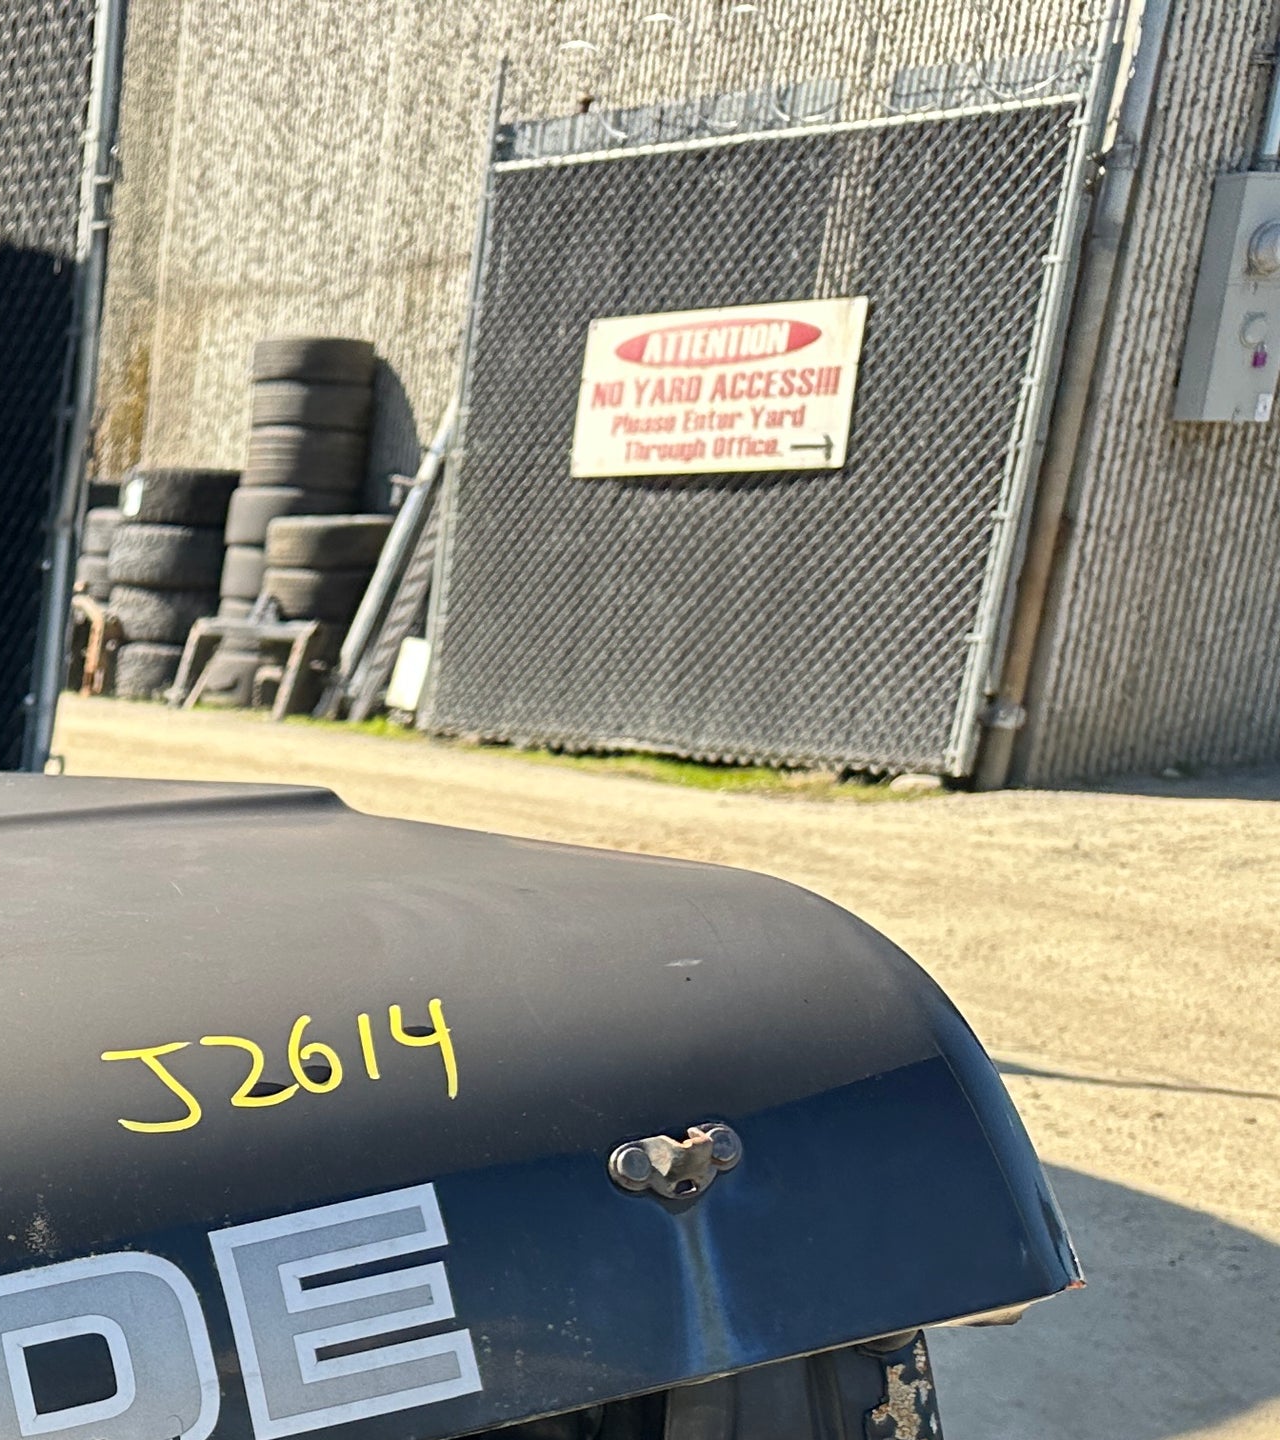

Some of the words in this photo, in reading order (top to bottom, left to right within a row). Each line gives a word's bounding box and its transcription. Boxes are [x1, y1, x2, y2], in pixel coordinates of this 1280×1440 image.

[642, 321, 790, 363] ATTENTION
[592, 380, 624, 409] NO
[634, 375, 703, 406] YARD
[710, 366, 842, 401] ACCESS!!!
[611, 414, 677, 437] Please
[682, 411, 742, 432] Enter
[751, 405, 806, 429] Yard
[625, 438, 706, 463] Through
[101, 998, 458, 1132] J2614
